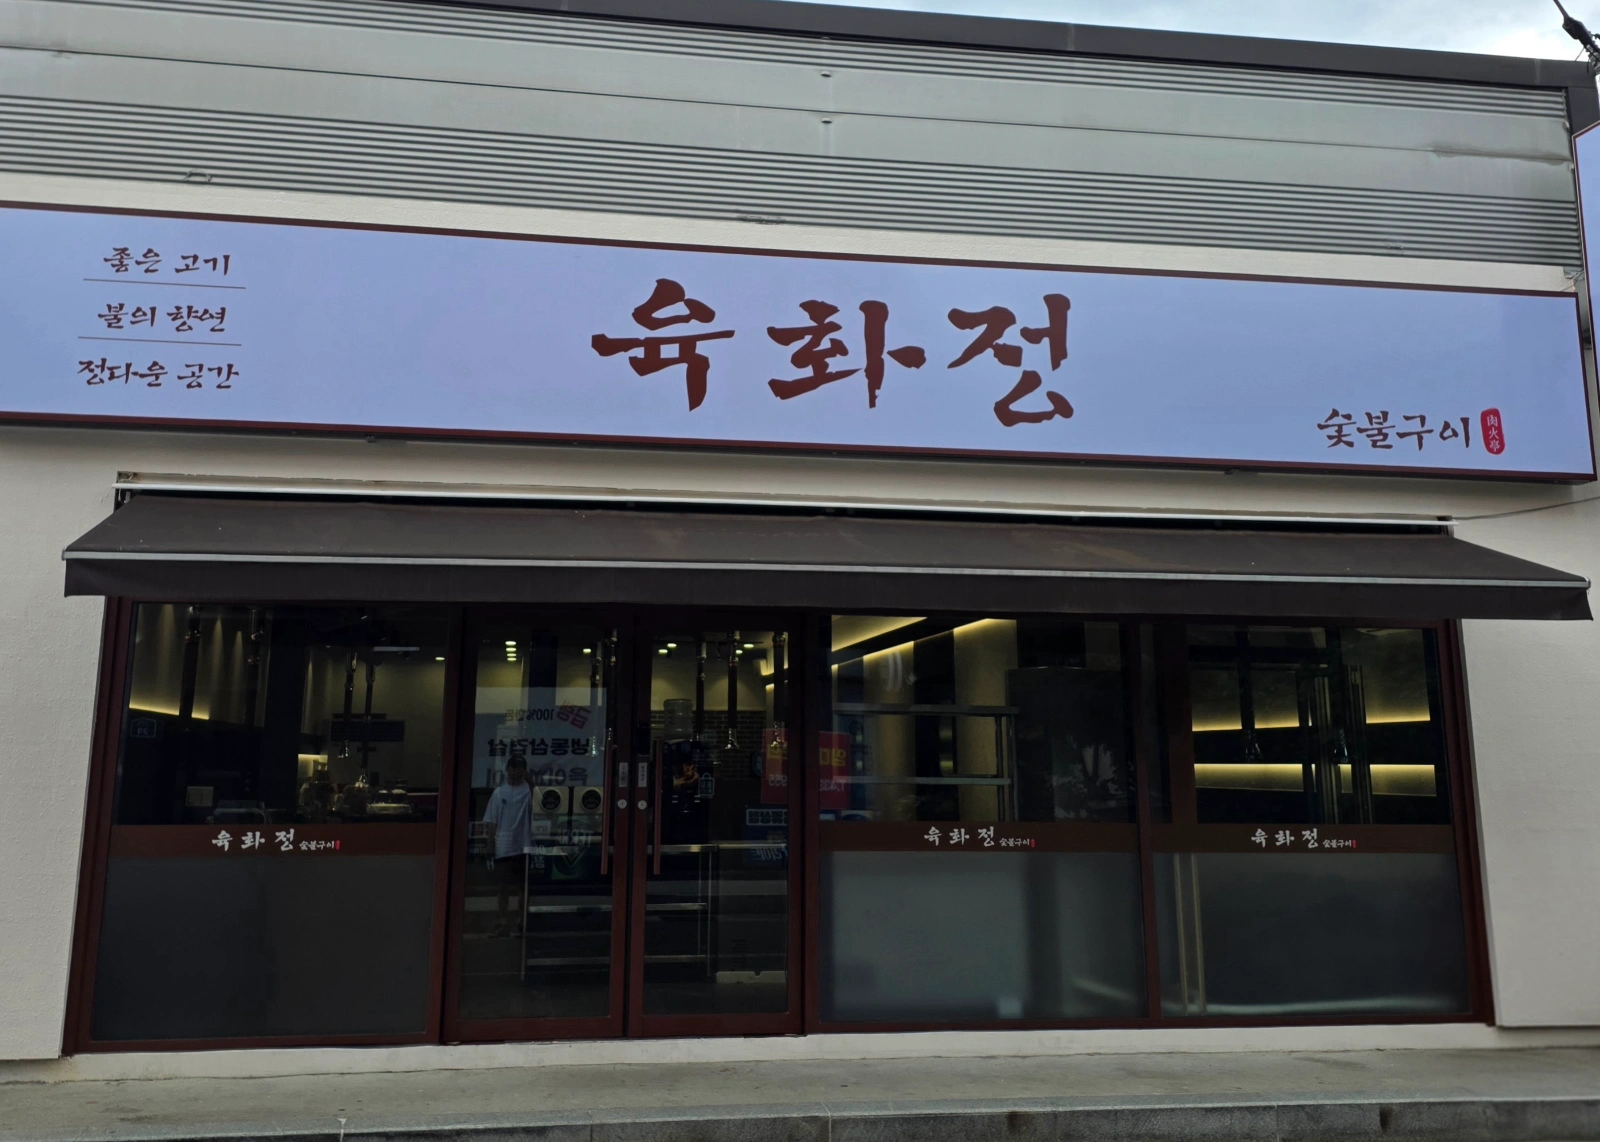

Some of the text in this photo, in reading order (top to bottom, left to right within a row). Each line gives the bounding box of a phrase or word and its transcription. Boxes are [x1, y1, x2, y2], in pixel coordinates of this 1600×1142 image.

[103, 247, 231, 276] 좋은 고기
[97, 302, 227, 333] 불의 향연
[591, 277, 1074, 428] 육화정
[77, 357, 240, 390] 정다운 공간
[1317, 408, 1471, 451] 숯불구이
[1486, 414, 1501, 453] 肉火亭
[212, 828, 295, 852] 육화정
[923, 825, 995, 847] 육화정
[1250, 827, 1319, 849] 육화정
